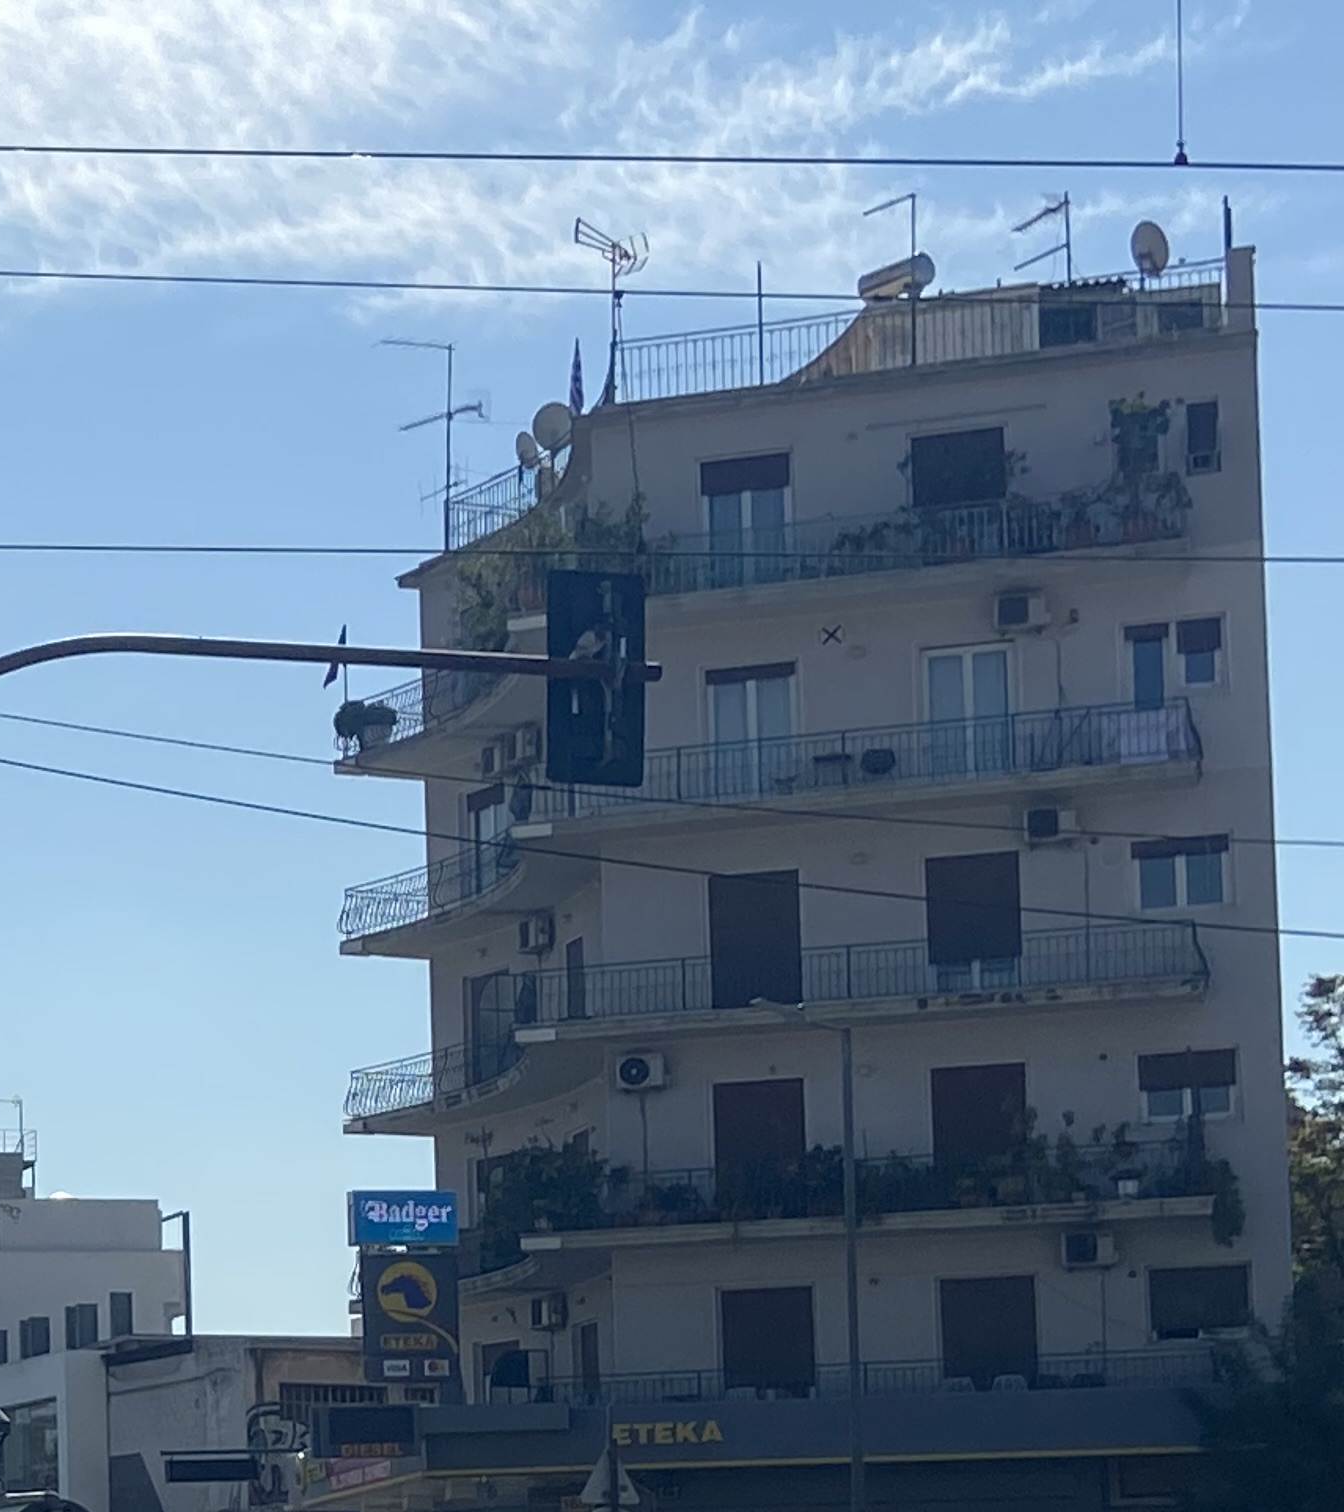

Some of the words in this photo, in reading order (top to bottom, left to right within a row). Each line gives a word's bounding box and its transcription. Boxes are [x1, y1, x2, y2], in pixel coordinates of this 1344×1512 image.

[364, 1200, 452, 1232] Badger
[613, 1420, 724, 1446] ETEKA
[341, 1443, 404, 1457] DIESEL
